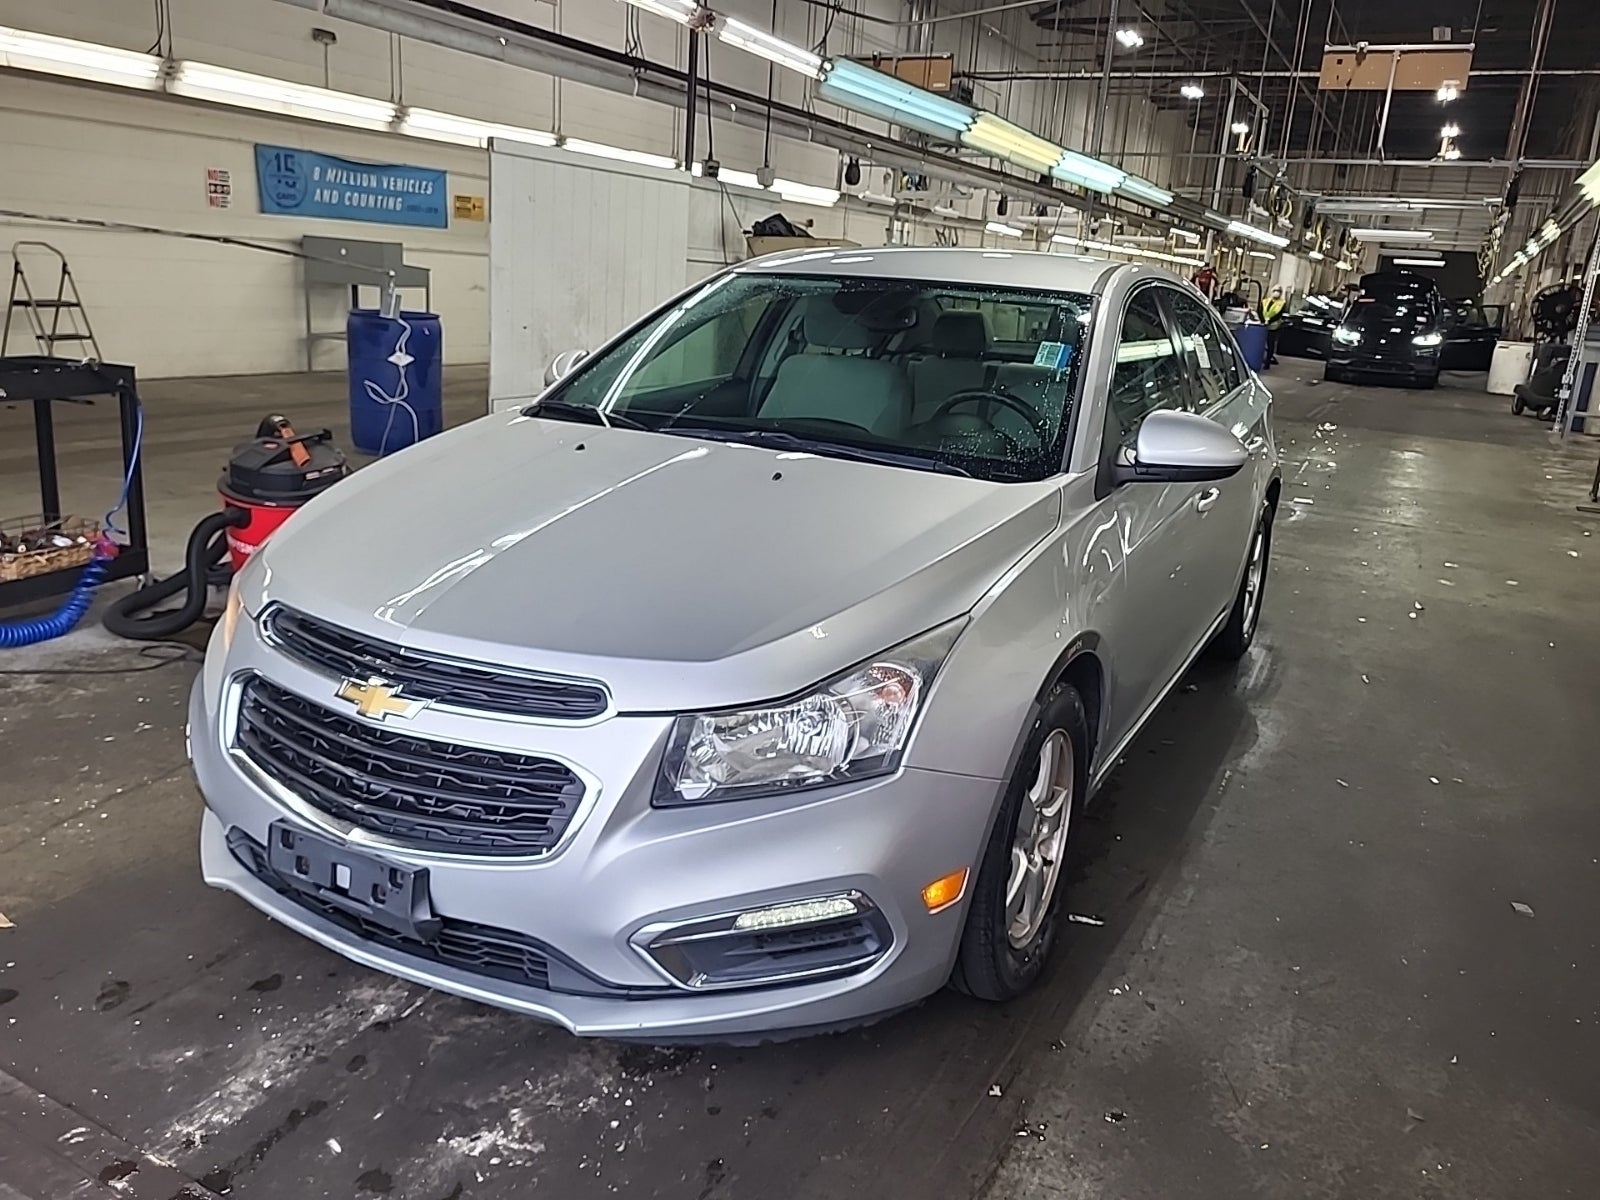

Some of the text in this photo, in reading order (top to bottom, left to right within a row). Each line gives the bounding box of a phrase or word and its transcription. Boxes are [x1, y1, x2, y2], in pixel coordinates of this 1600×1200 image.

[313, 166, 433, 195] 8 MILLION VEHICLES
[314, 188, 339, 204] AND
[344, 191, 403, 211] COUNTING
